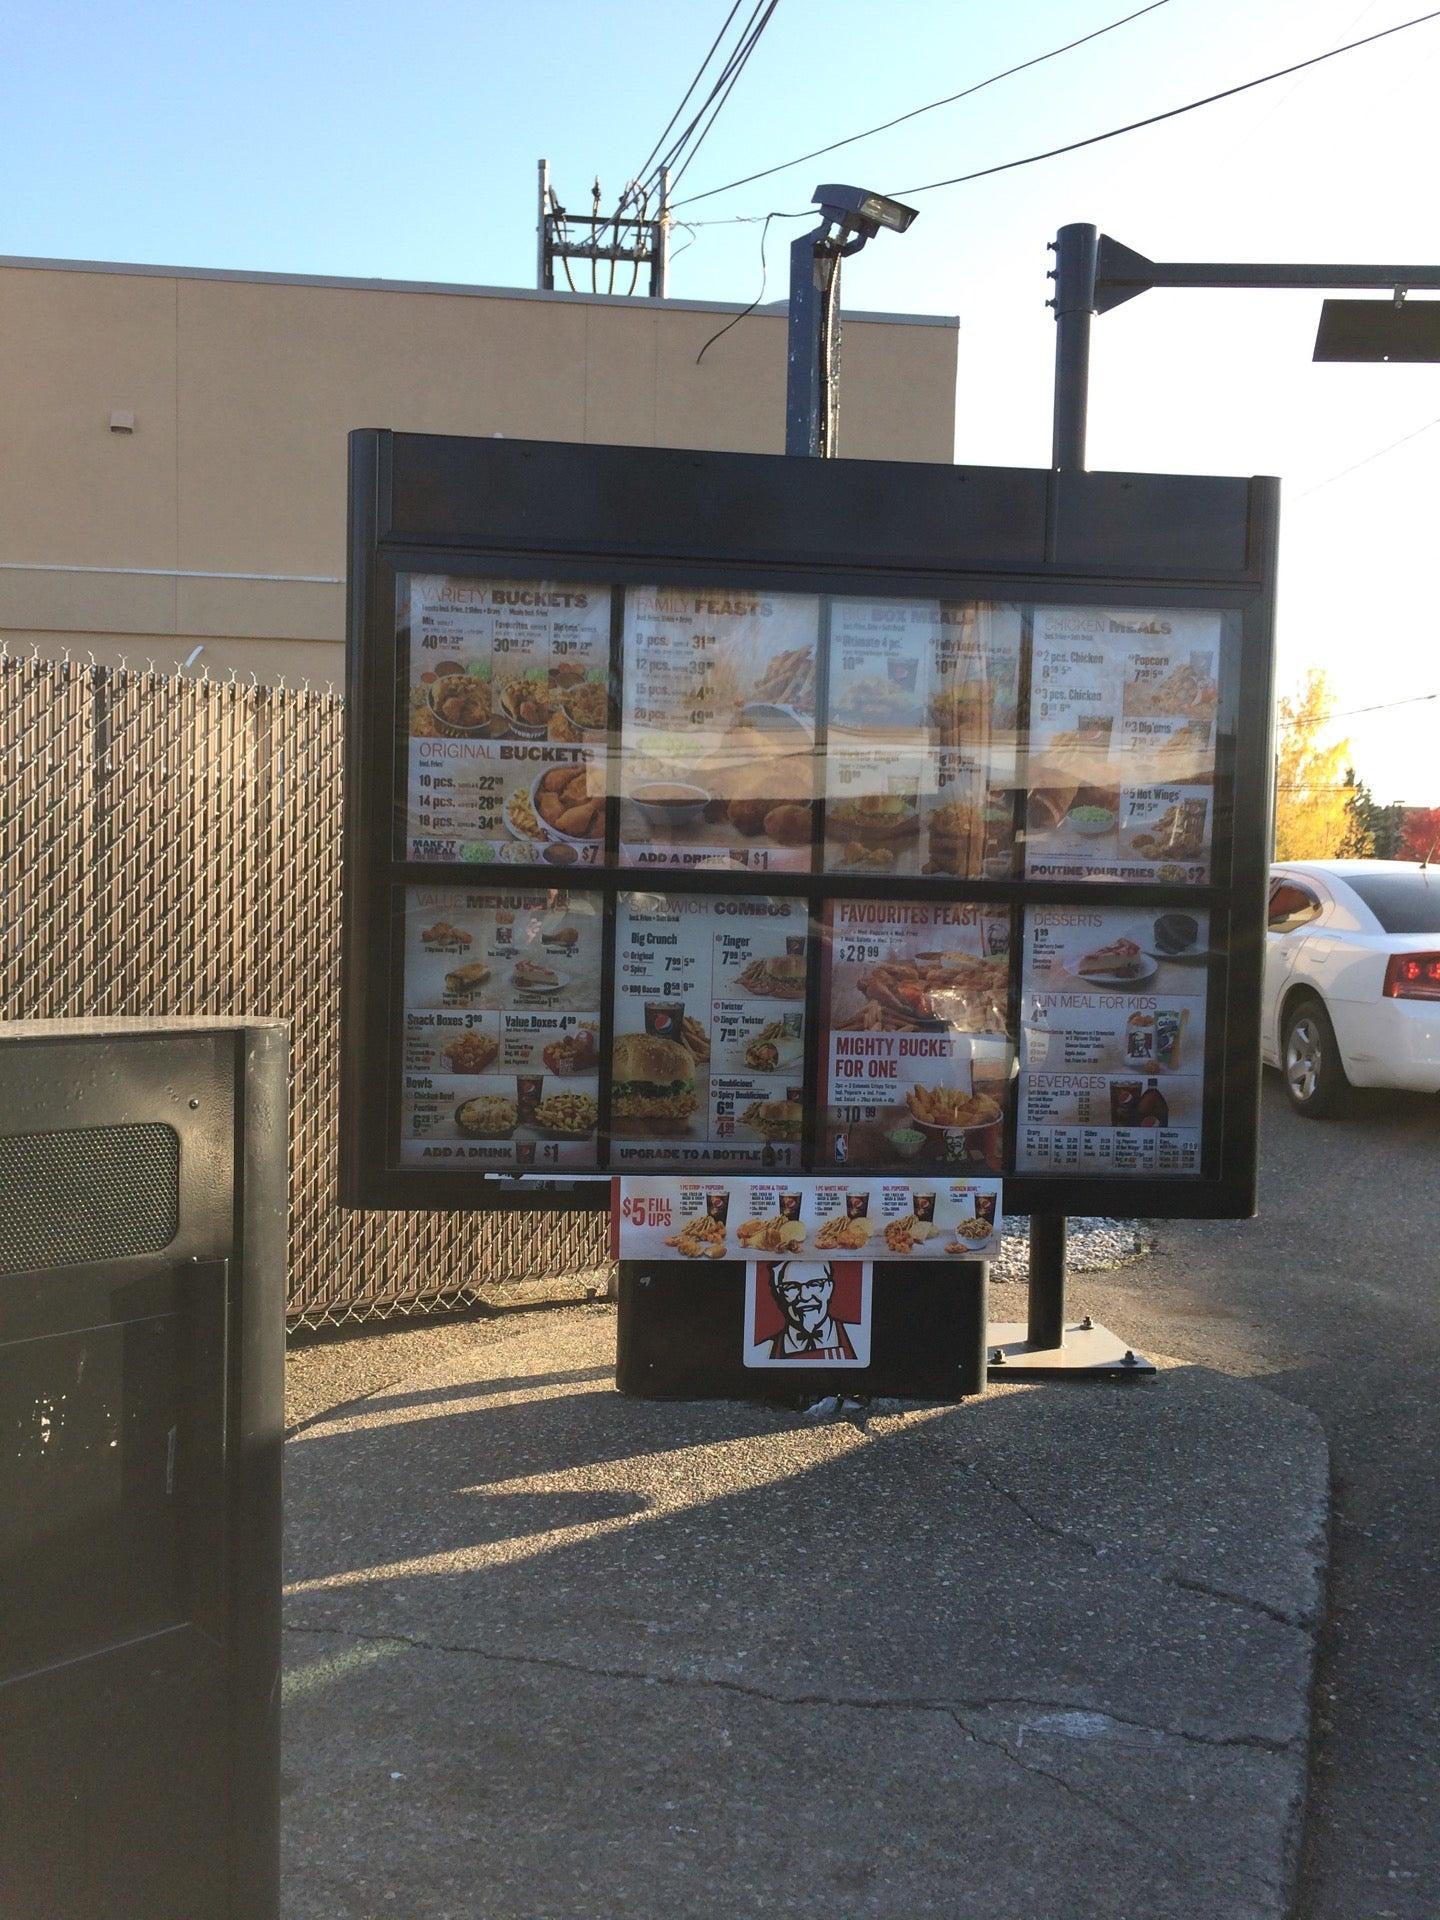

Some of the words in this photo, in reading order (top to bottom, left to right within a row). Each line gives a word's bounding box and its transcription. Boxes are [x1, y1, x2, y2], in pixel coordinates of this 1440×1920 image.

[421, 587, 487, 604] VARIETY
[492, 590, 588, 608] BUCKETS
[637, 599, 690, 613] FAMILY
[695, 600, 773, 618] FEASTS
[871, 608, 906, 622] BOX
[422, 617, 434, 625] Mix
[1046, 616, 1104, 633] CHICKEN
[1109, 620, 1172, 635] MEALS
[647, 635, 668, 648] pcs.
[636, 658, 647, 670] 12
[649, 661, 671, 673] pcs.
[1043, 652, 1049, 661] 2
[1051, 653, 1068, 665] pcs.
[1070, 652, 1103, 664] Chicken
[1135, 654, 1169, 666] Popcorn
[1041, 689, 1047, 698] 3
[1049, 690, 1066, 701] pcs.
[1069, 689, 1102, 701] Chicken
[1131, 722, 1137, 732] 3
[419, 743, 495, 759] ORIGINAL
[500, 746, 595, 762] BUCKETS
[419, 775, 431, 787] 10
[433, 776, 456, 790] pcs.
[1130, 789, 1136, 799] 5
[1137, 787, 1151, 799] Hot
[1154, 789, 1180, 802] Wings
[419, 795, 431, 807] 14
[432, 797, 455, 810] pcs.
[419, 815, 430, 826] 18
[432, 817, 455, 830] pcs.
[413, 840, 443, 848] MAKE
[445, 841, 456, 849] IT
[582, 845, 599, 864] $7
[639, 852, 667, 863] ADD
[670, 853, 680, 863] A
[754, 851, 768, 869] $1
[1031, 865, 1085, 876] POUTINE
[1086, 866, 1119, 877] YOUR
[1121, 867, 1155, 878] FRIES
[1188, 866, 1206, 884] $2
[417, 893, 463, 906] VALUE
[466, 895, 521, 909] MENU
[631, 899, 708, 914] SANDWICH
[714, 902, 791, 916] COMBOS
[841, 904, 928, 925] FAVOURITES
[933, 907, 978, 926] FEAST
[1033, 913, 1102, 927] DESSERTS
[631, 933, 644, 946] Big
[646, 933, 677, 945] Crunch
[722, 934, 750, 949] Zinger
[631, 952, 654, 960] Original
[631, 965, 647, 974] Spicy
[630, 985, 642, 994] BBQ
[643, 986, 660, 994] Bacon
[721, 1002, 743, 1011] Twister
[1031, 995, 1057, 1007] FUN
[1060, 995, 1096, 1008] MEAL
[1100, 996, 1124, 1009] FOR
[1127, 997, 1157, 1009] KIDS
[407, 1013, 434, 1026] Snack
[436, 1015, 463, 1026] Boxes
[505, 1016, 529, 1027] Value
[531, 1016, 557, 1028] Boxes
[720, 1016, 739, 1025] Zinger
[742, 1016, 764, 1024] Twister
[836, 1038, 894, 1056] MIGHTY
[899, 1039, 957, 1058] BUCKET
[835, 1059, 863, 1077] FOR
[868, 1060, 898, 1078] ONE
[406, 1077, 432, 1089] Bowls
[1028, 1075, 1106, 1089] BEVERAGES
[414, 1092, 438, 1100] Chicken
[440, 1092, 454, 1100] Bowl
[718, 1091, 734, 1100] Spicy
[423, 1147, 452, 1158] ADD
[456, 1148, 465, 1158] A
[468, 1147, 512, 1158] DRINK
[544, 1144, 559, 1163] $1
[620, 1149, 679, 1160] UPGRADE
[683, 1150, 700, 1159] TO
[702, 1150, 711, 1159] A
[713, 1150, 761, 1160] BOTTLE
[777, 1147, 791, 1164] $1
[622, 1197, 646, 1226] $5
[648, 1198, 672, 1212] FILL
[648, 1213, 672, 1227] UPS
